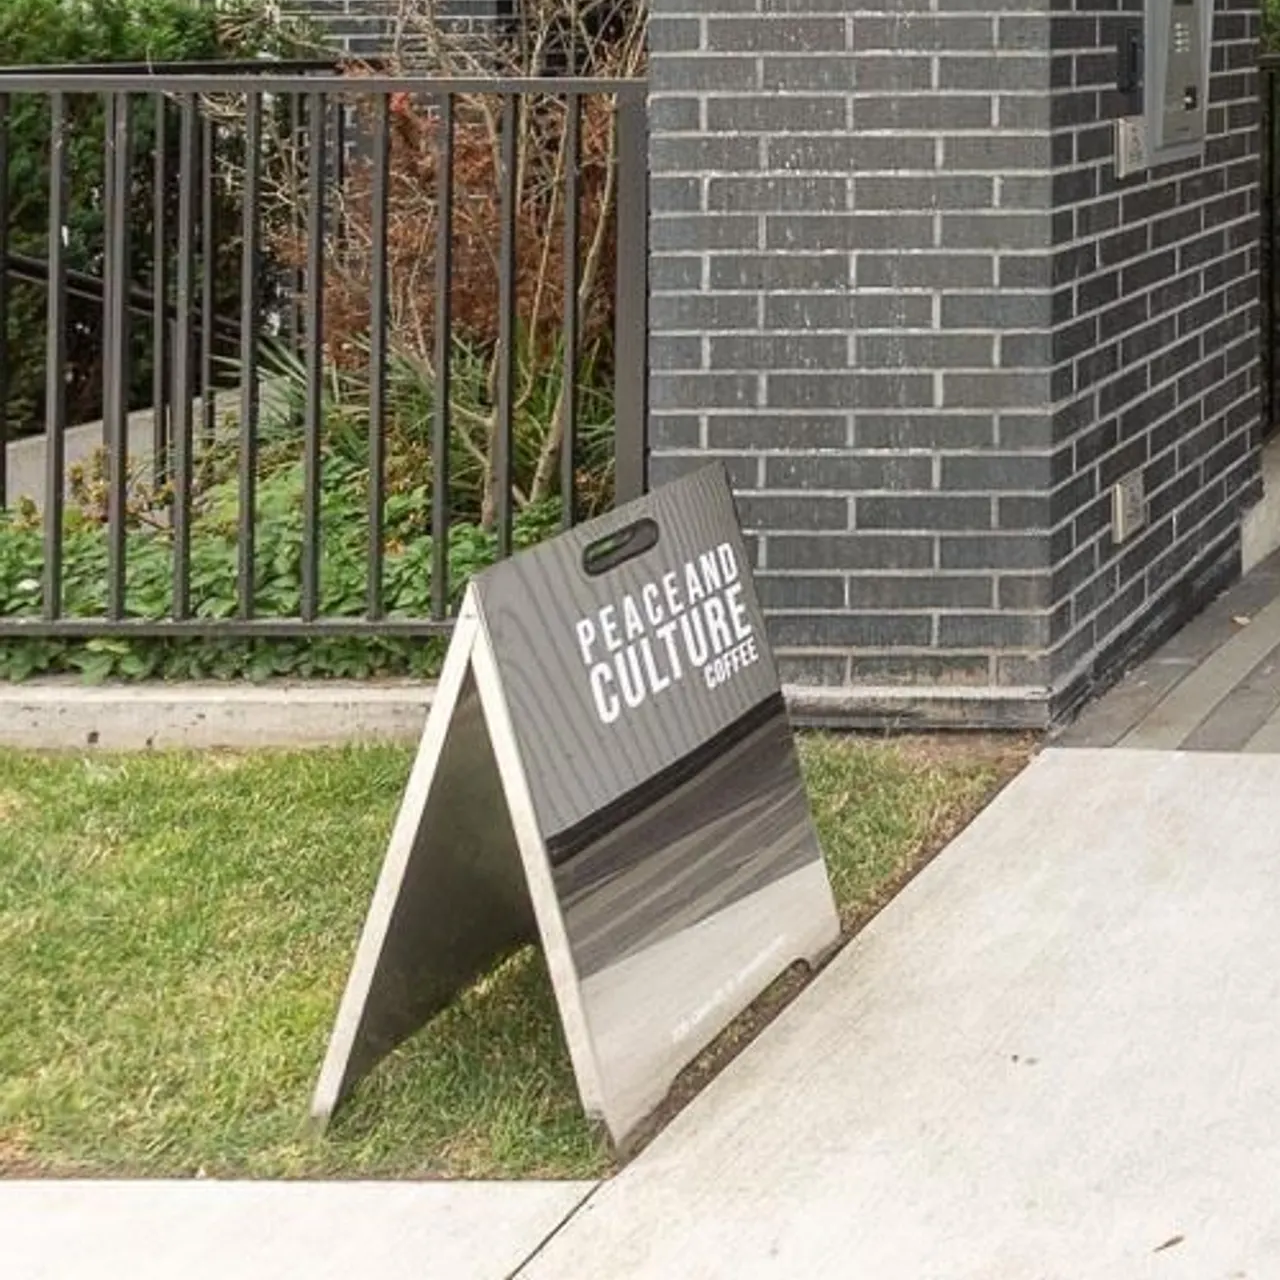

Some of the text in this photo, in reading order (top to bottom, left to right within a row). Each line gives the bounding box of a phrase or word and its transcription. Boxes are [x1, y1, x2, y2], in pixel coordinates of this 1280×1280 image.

[576, 542, 739, 665] PEACE AND
[589, 582, 753, 724] CULTURE
[703, 636, 759, 691] COFFEE
